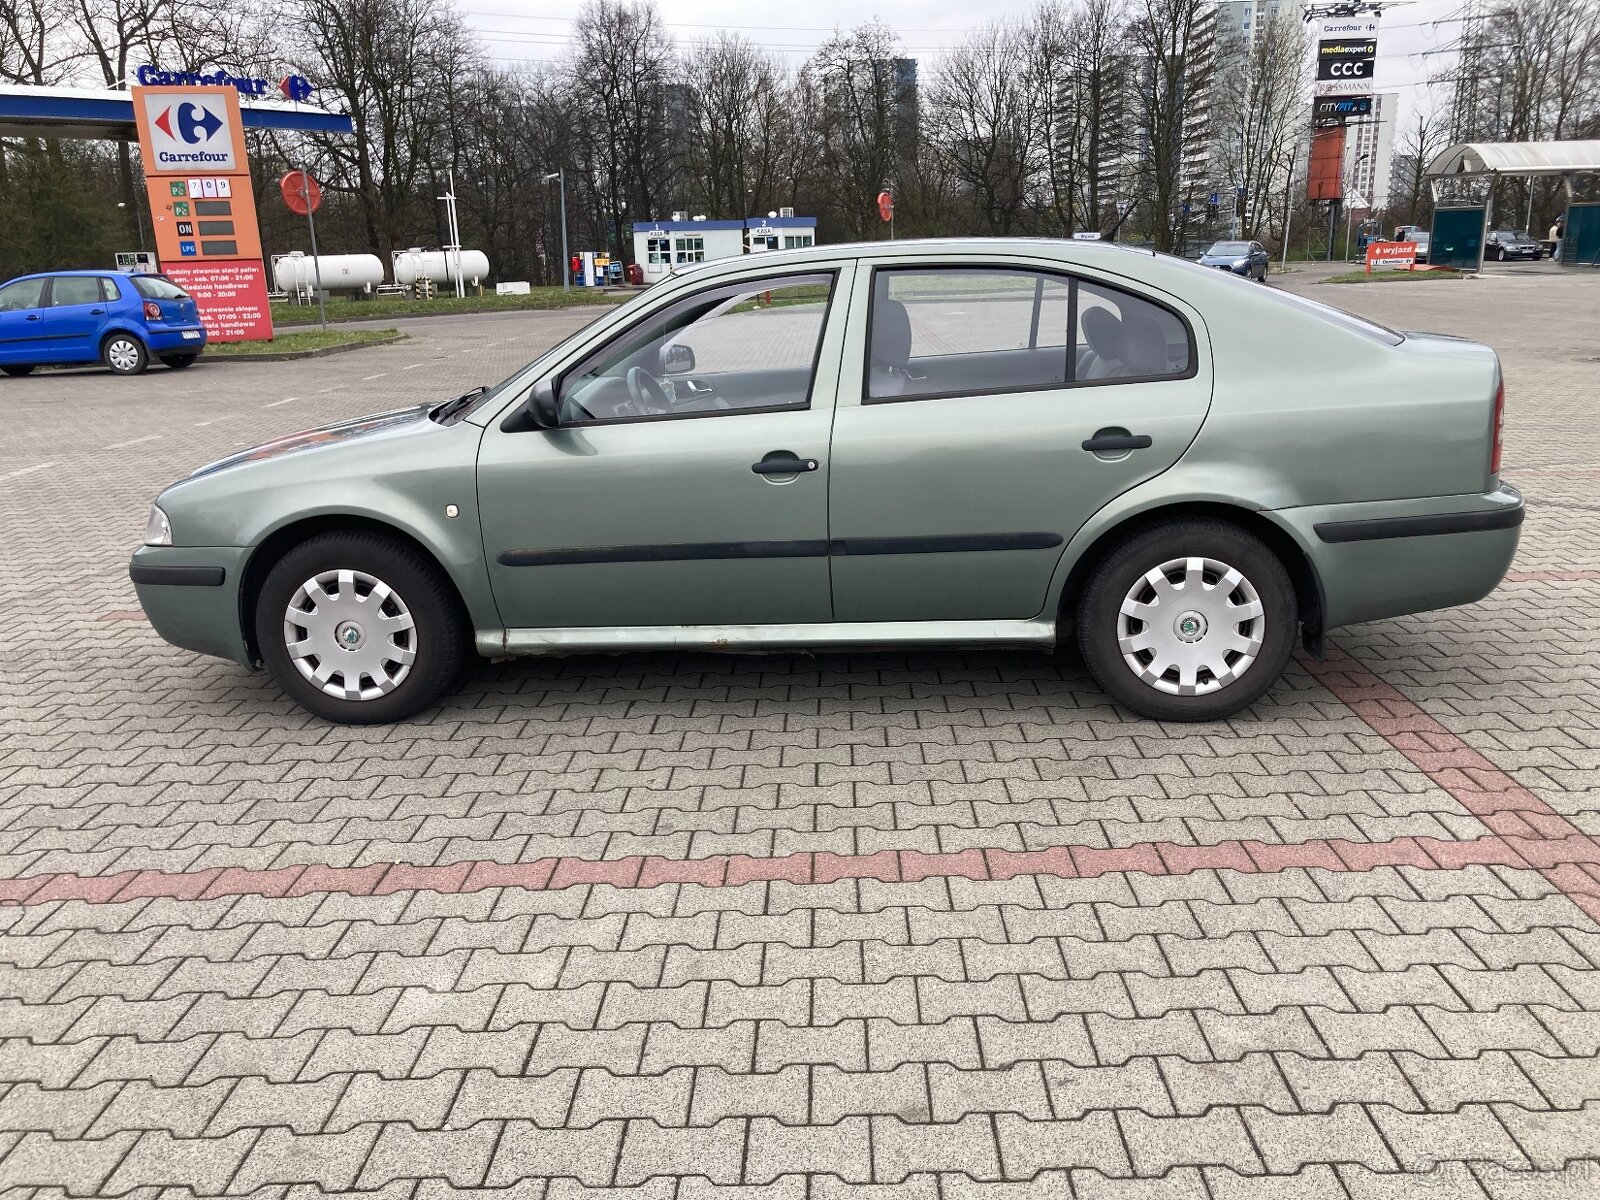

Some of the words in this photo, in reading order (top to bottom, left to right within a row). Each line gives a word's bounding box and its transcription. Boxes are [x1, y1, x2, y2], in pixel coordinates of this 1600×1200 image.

[1324, 24, 1362, 32] Carrefour
[1321, 45, 1366, 54] mediaexpert
[1330, 62, 1364, 76] CCC
[137, 64, 268, 94] Carrefour
[159, 151, 228, 162] Carrefour
[179, 224, 192, 234] ON
[1383, 246, 1412, 254] wyjazd
